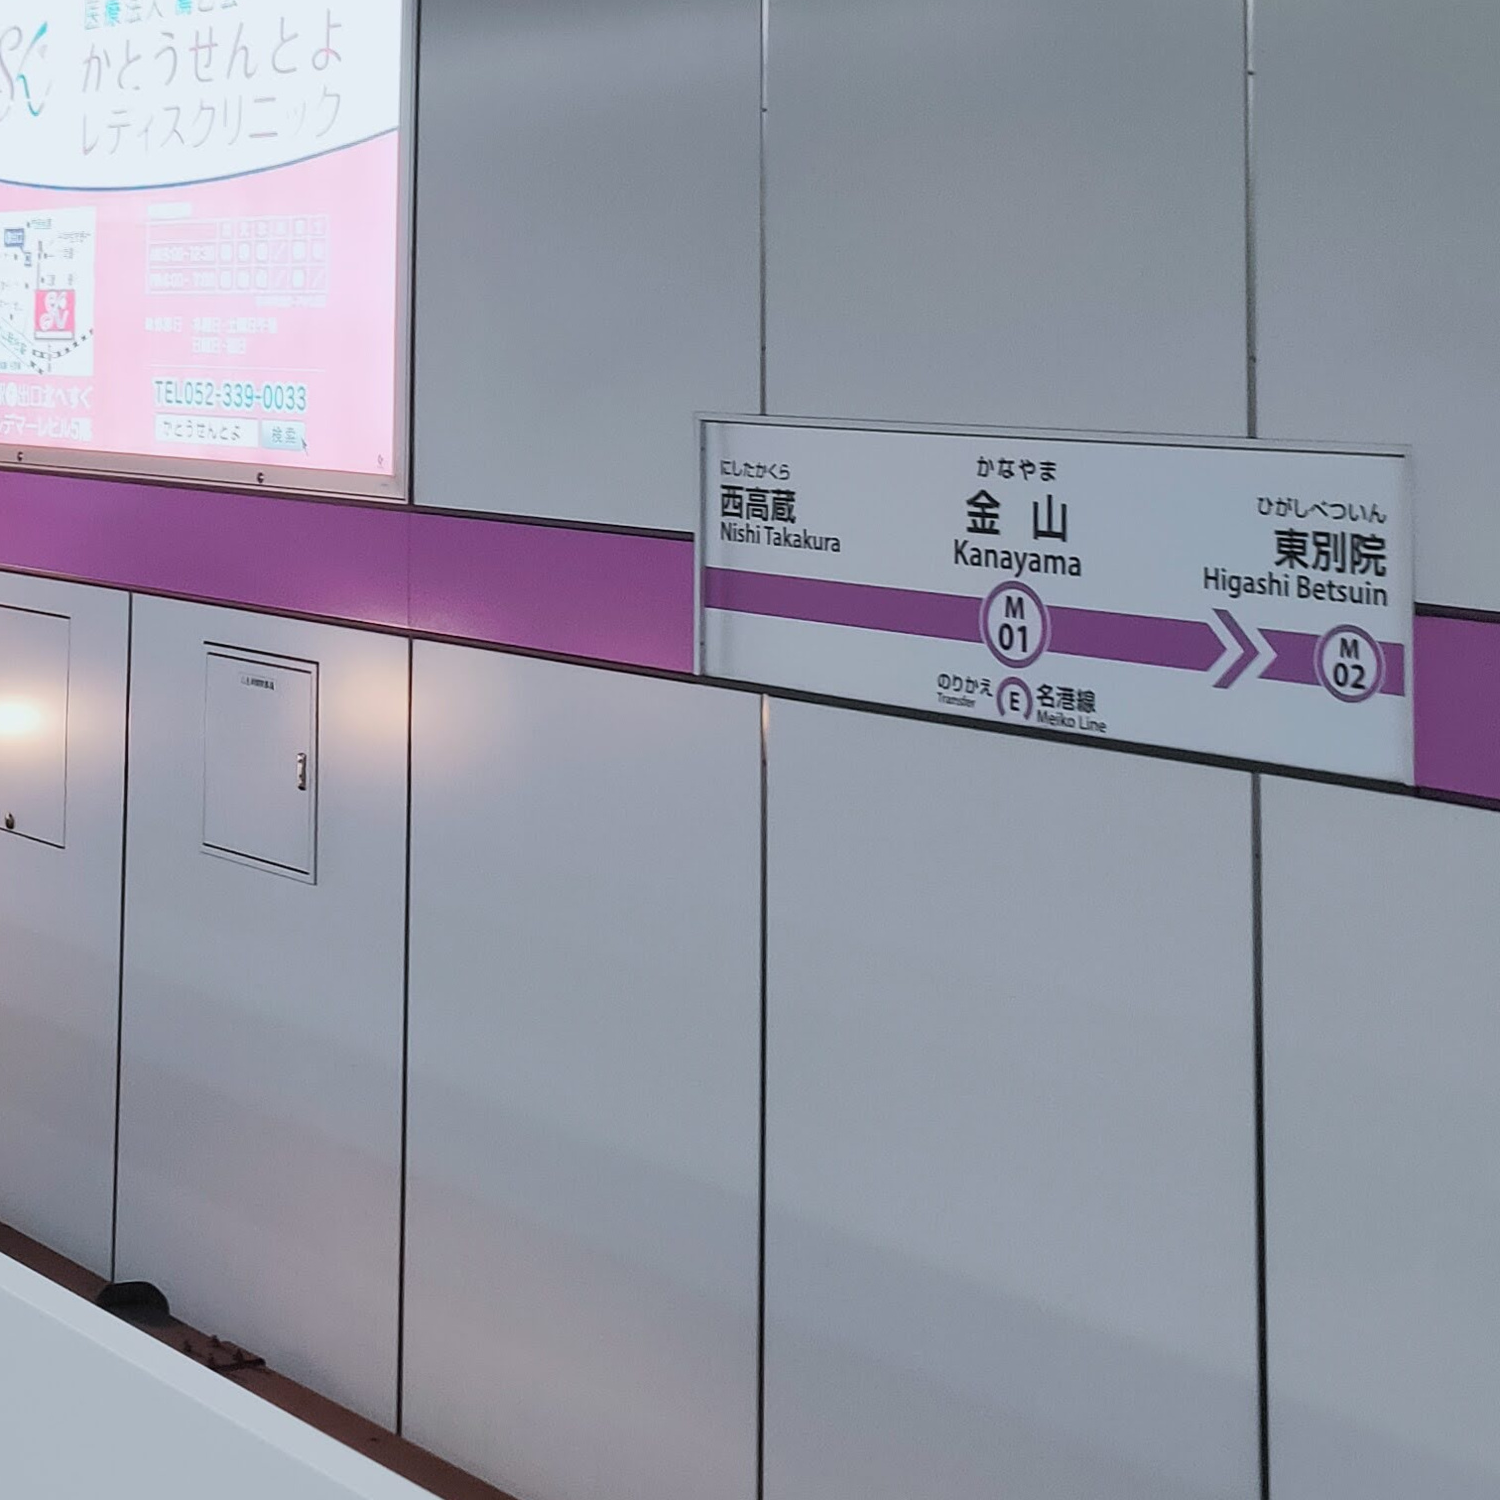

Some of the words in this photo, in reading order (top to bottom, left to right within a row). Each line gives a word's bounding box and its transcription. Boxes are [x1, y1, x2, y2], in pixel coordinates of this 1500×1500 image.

[81, 8, 343, 93] かとうせんとよ
[154, 380, 308, 411] TEL052-339-0033
[720, 459, 791, 480] にしたかくら
[976, 455, 1058, 482] かなやま
[720, 484, 797, 524] 西高蔵
[1256, 496, 1388, 525] ひがしべついん
[719, 521, 761, 545] Nishi
[763, 525, 841, 553] Takakura
[953, 538, 1082, 578] Kanayama
[1273, 527, 1387, 578] 東別院
[1202, 566, 1290, 600] Higashi
[1296, 575, 1389, 607] Betsuin
[1004, 595, 1025, 620] M
[998, 622, 1029, 653] 01
[1339, 637, 1360, 660] M
[936, 672, 994, 698] のりかえ
[1332, 662, 1367, 690] 02
[1008, 691, 1021, 712] E
[1035, 682, 1097, 714] 名港線
[1036, 708, 1077, 729] Meiko
[1078, 713, 1108, 733] Line
